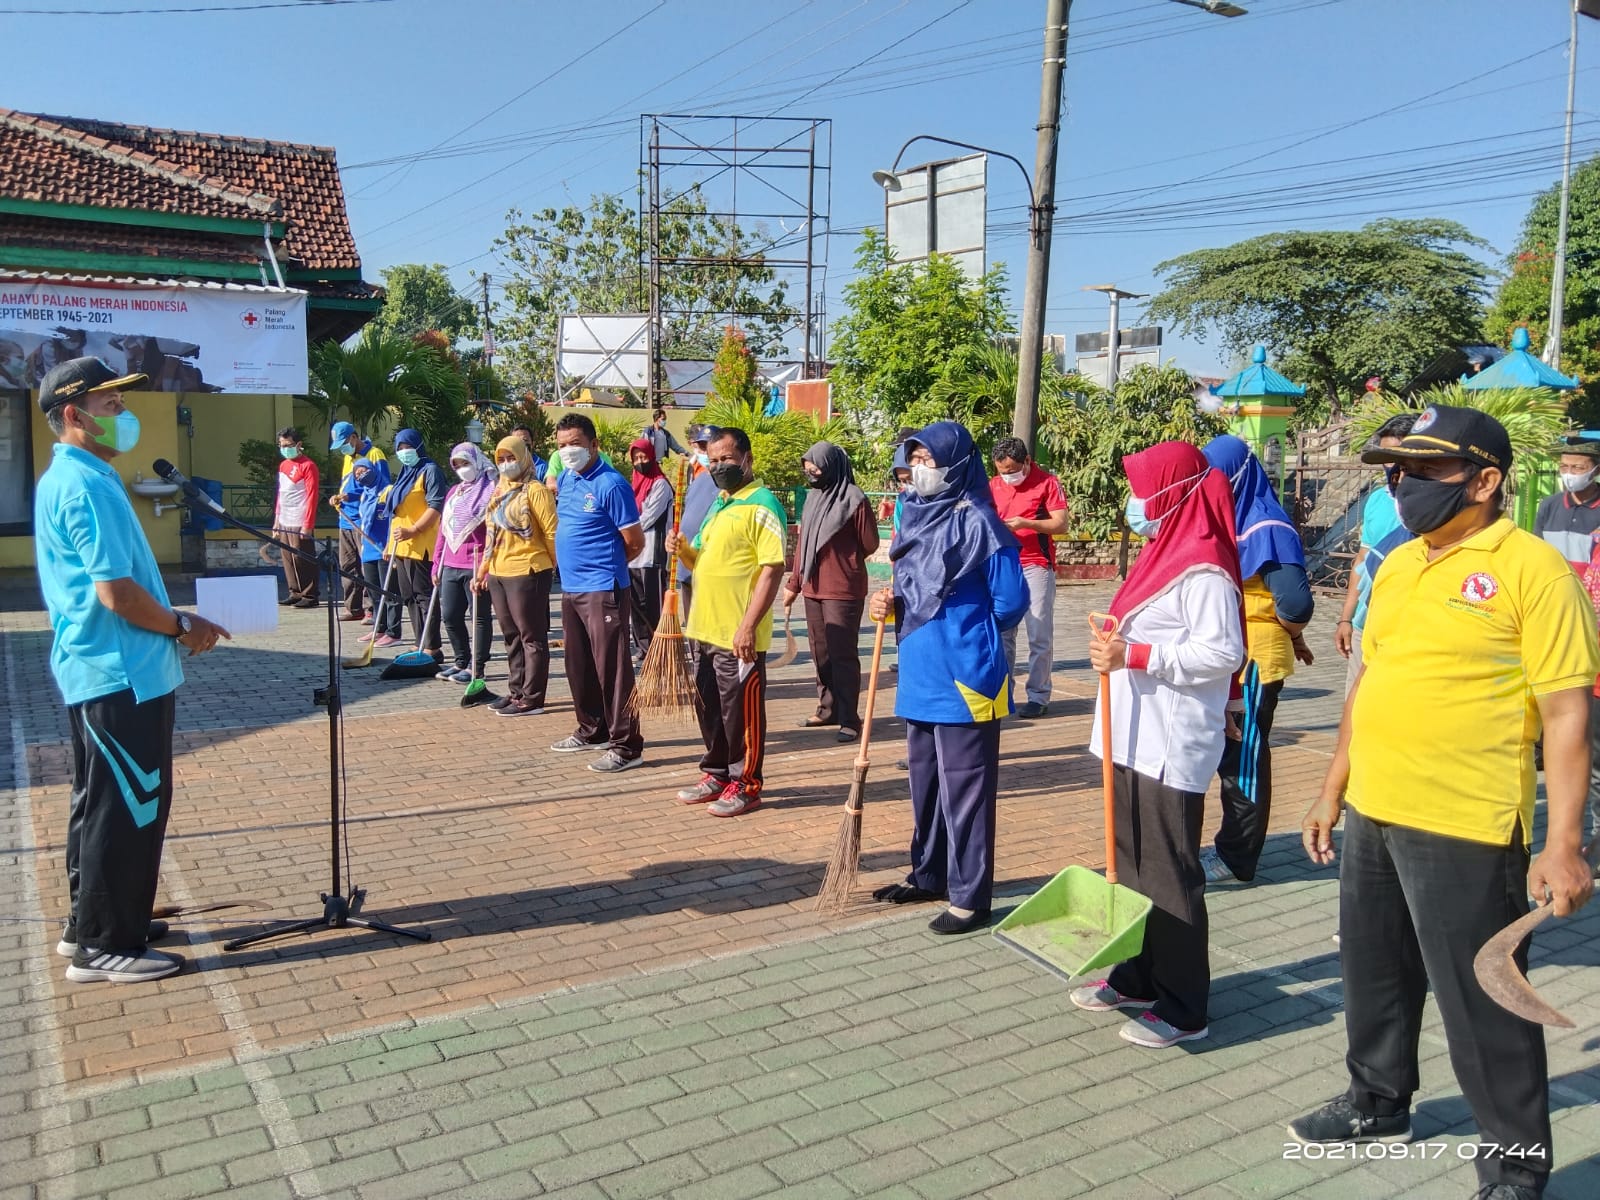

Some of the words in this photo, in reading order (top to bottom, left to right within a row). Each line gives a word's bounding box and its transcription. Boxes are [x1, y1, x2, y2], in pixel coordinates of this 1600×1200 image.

[42, 294, 87, 308] PALANG
[90, 297, 128, 310] MERAH
[131, 299, 188, 312] INDONESIA
[57, 310, 113, 324] 1945-2021
[265, 308, 286, 316] Palang
